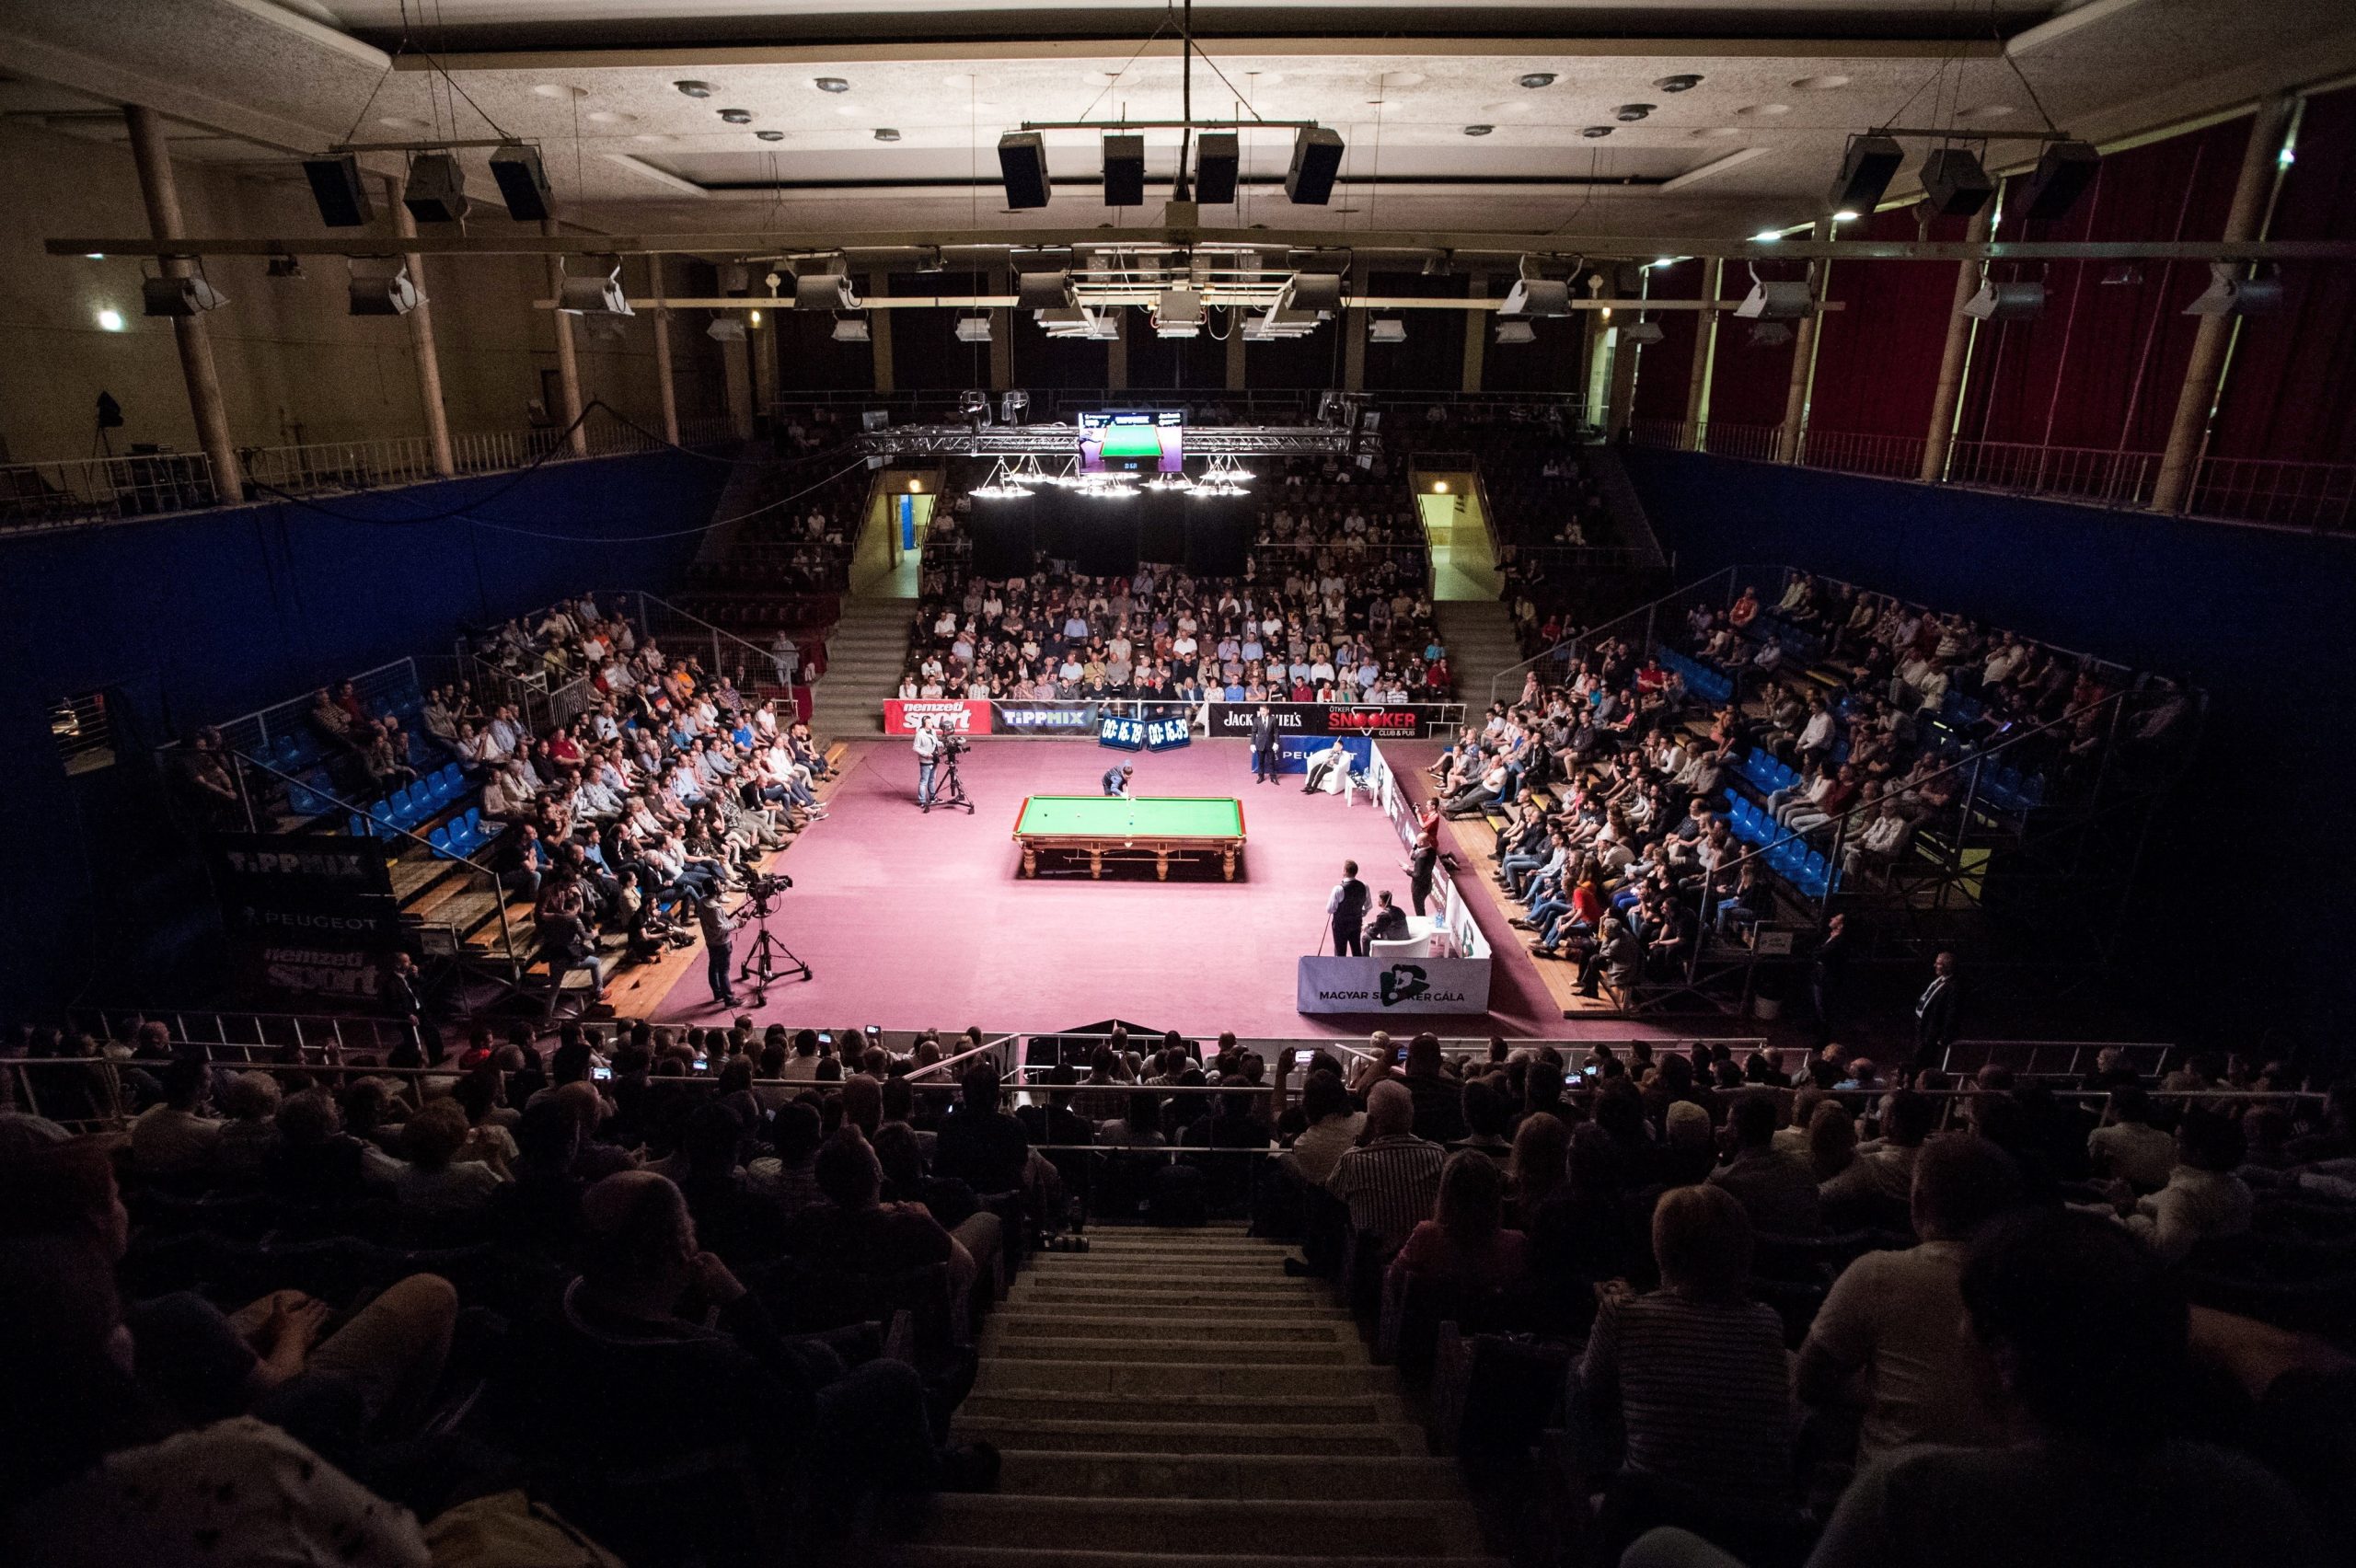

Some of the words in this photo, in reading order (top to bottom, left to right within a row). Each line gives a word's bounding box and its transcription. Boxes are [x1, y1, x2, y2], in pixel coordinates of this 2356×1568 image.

[904, 701, 964, 711] nemzeti
[1329, 705, 1350, 713] ÖTKER
[1223, 710, 1253, 727] JACK
[1328, 712, 1416, 728] SNOOKER
[1282, 751, 1357, 760] PEUT
[265, 912, 377, 930] PEUGEOT
[1319, 991, 1369, 1000] MAGYAR
[1434, 990, 1465, 1002] GÁLA
